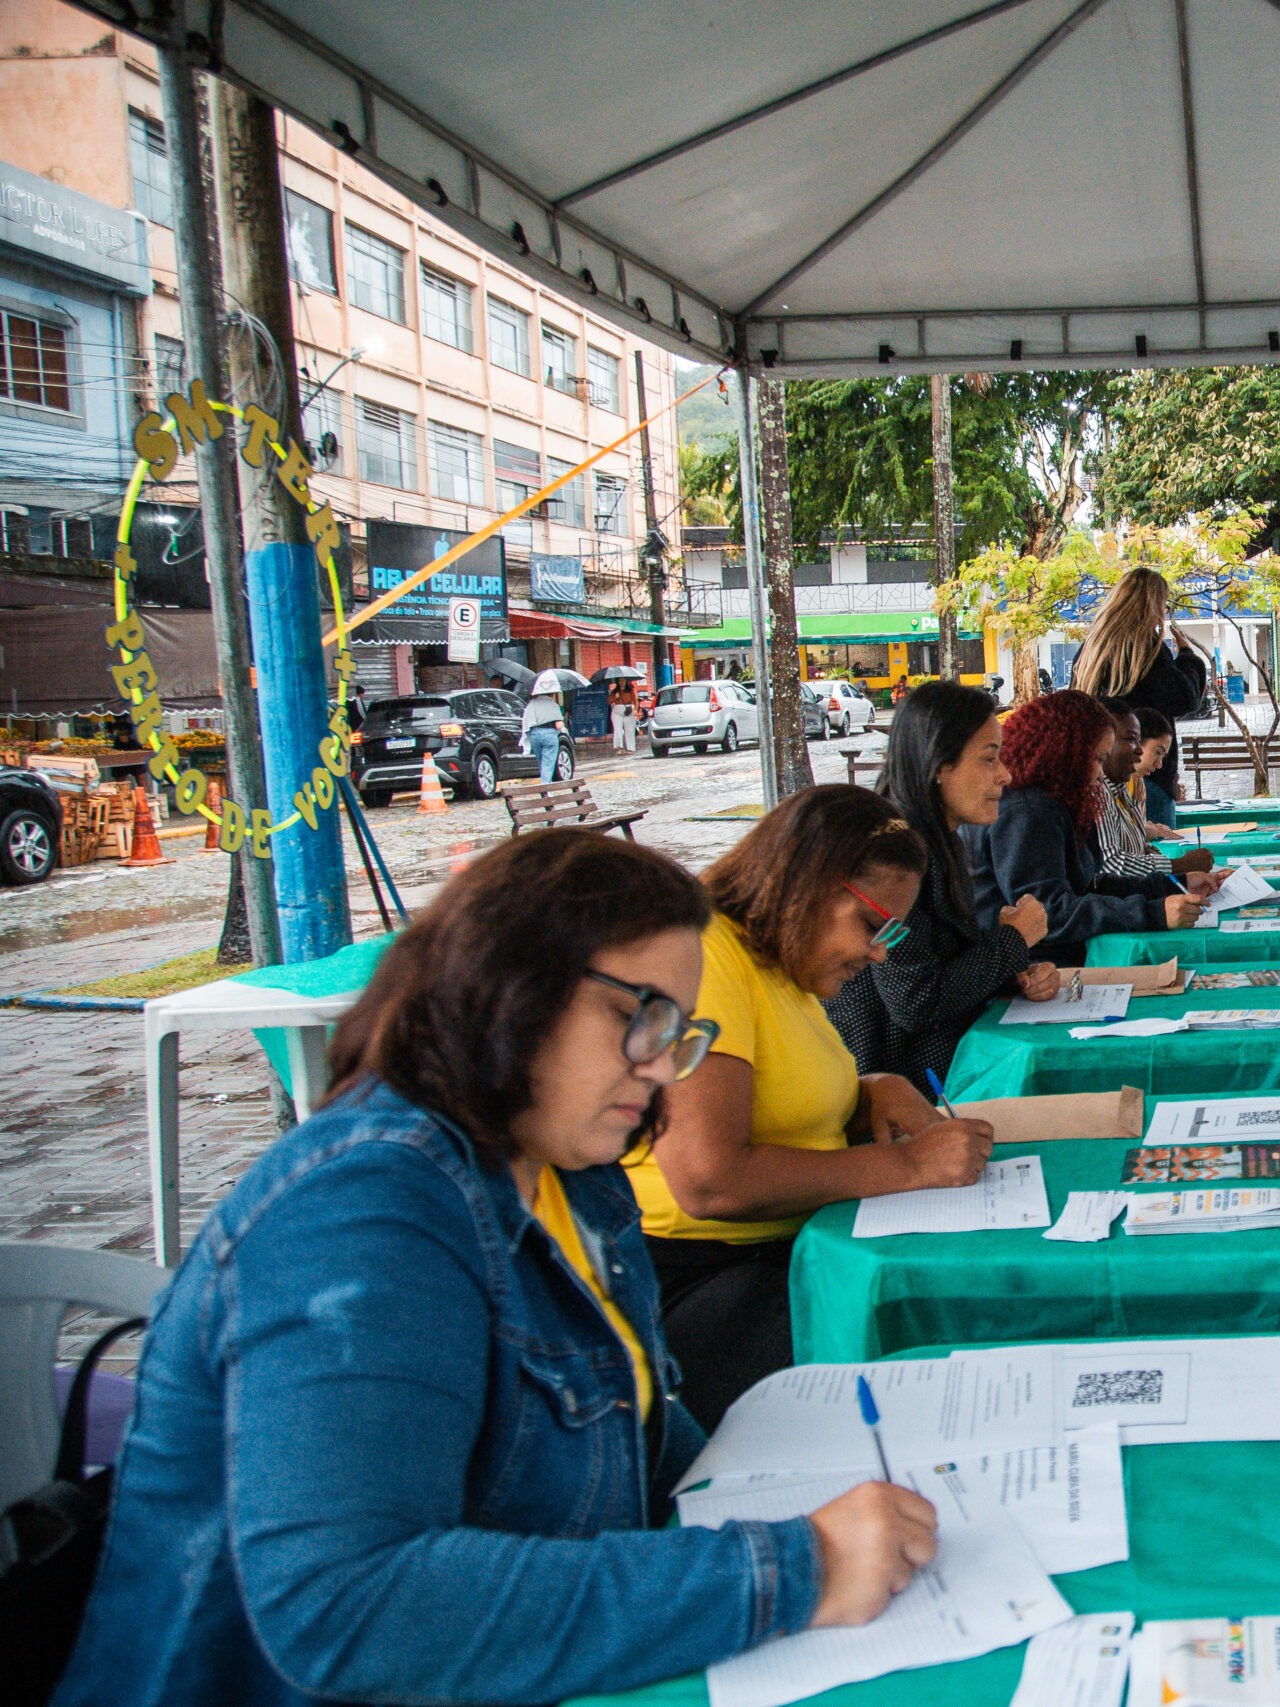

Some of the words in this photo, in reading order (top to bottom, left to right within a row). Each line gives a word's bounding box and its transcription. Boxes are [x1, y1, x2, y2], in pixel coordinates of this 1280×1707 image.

[0, 182, 66, 230] ICTOR
[430, 573, 503, 595] CELULAR
[428, 595, 450, 605] TÉCNIC
[460, 608, 470, 622] E
[105, 608, 208, 816] PERTO
[219, 798, 272, 860] DE
